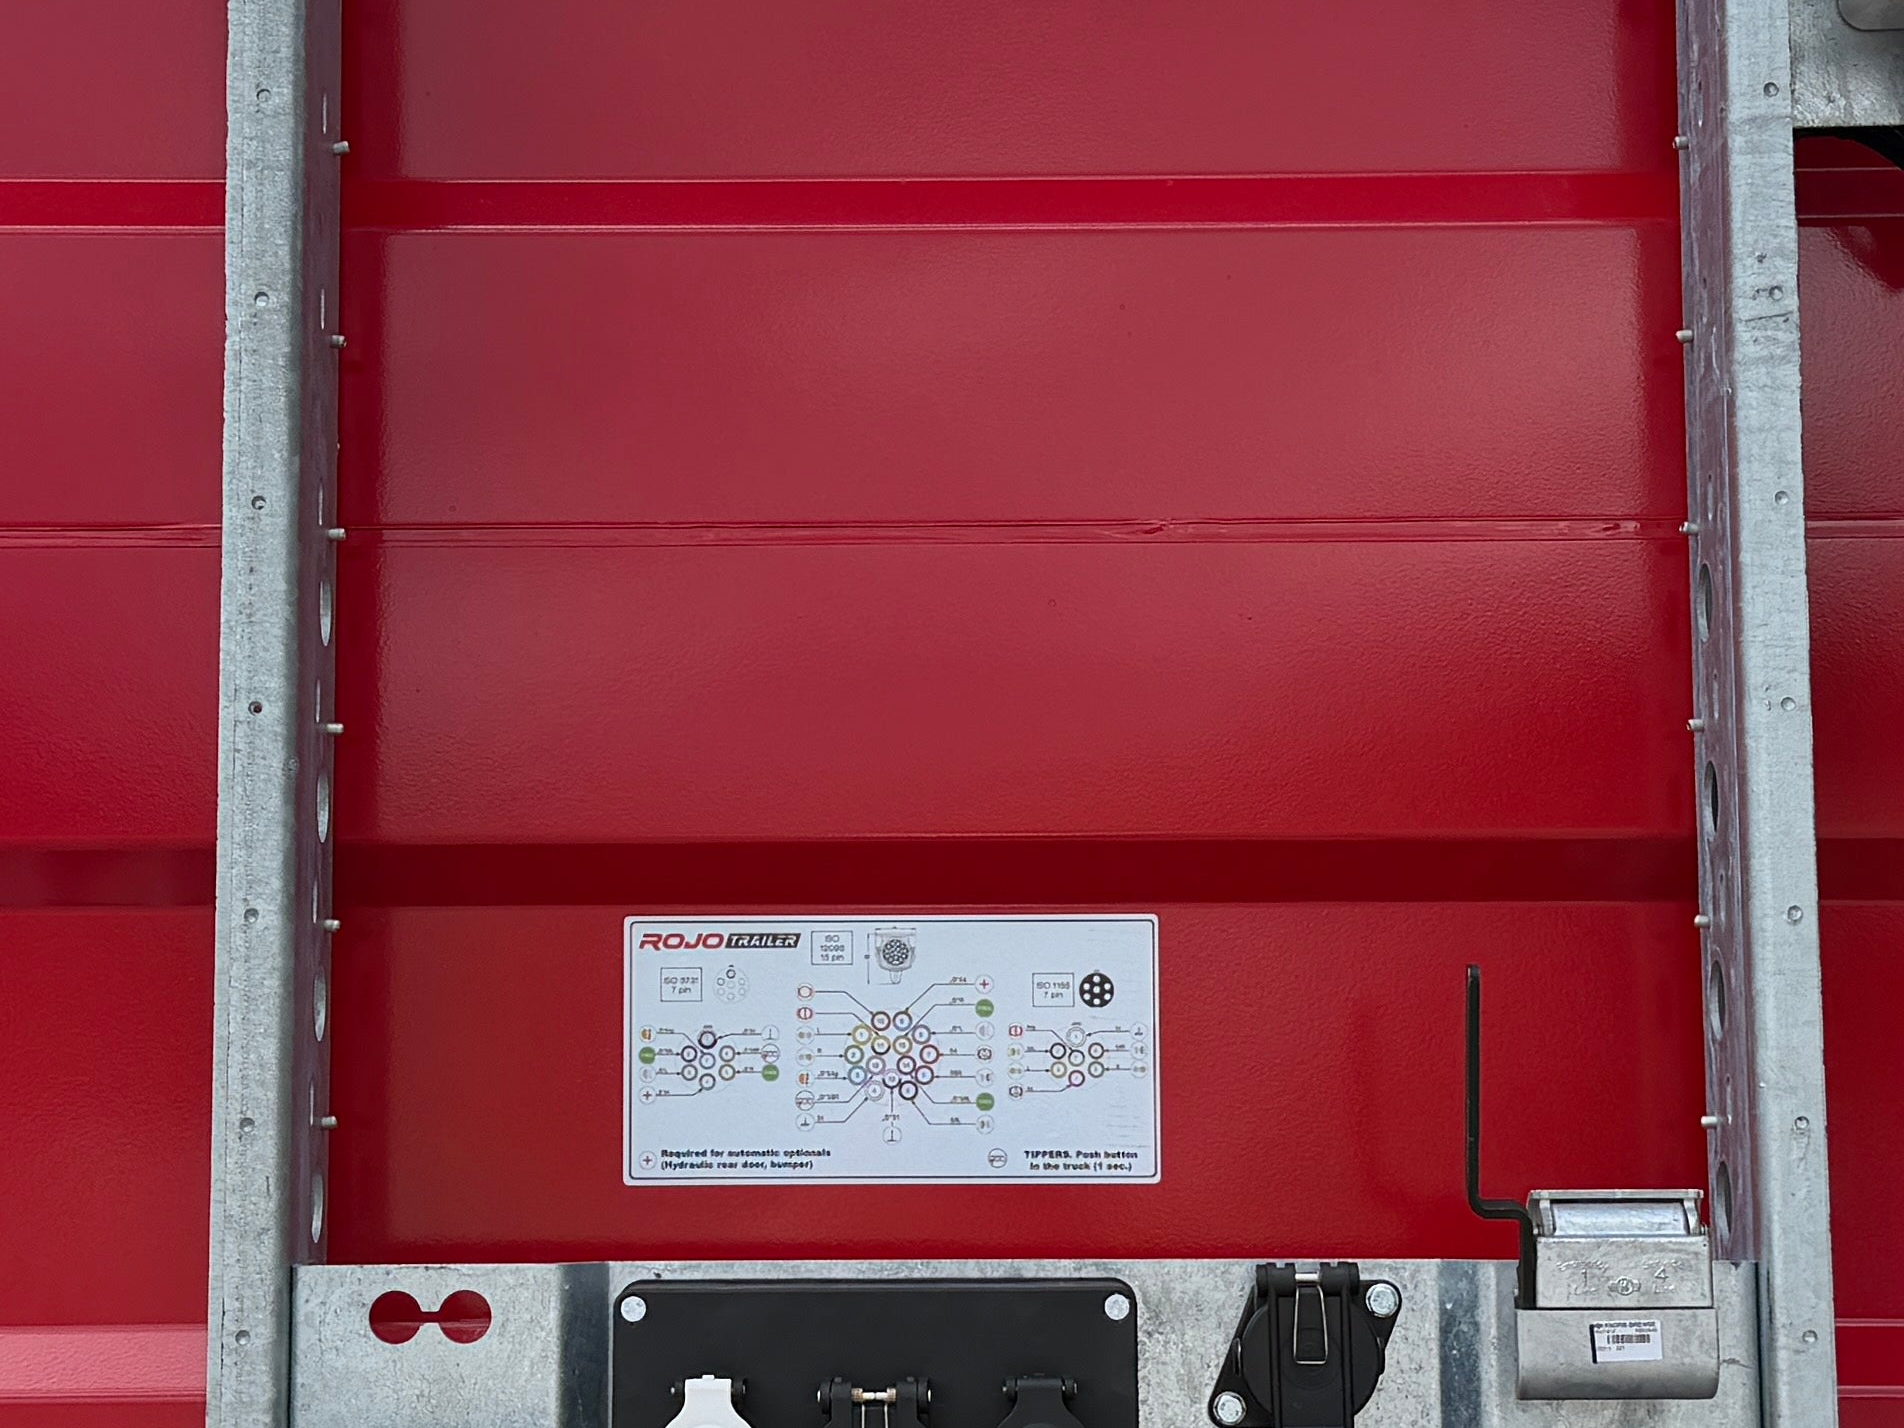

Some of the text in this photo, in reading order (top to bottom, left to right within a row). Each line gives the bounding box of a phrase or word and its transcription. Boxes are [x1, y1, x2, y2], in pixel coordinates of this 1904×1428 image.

[638, 933, 797, 951] ROJO TRAILER
[661, 1149, 831, 1159] Required for automatic optionals
[1024, 1151, 1138, 1159] TIPPERS. Push button
[661, 1160, 714, 1171] (Hydraulic
[741, 1160, 768, 1170] door,
[770, 1160, 814, 1170] bumper)
[1043, 1162, 1061, 1170] the
[1063, 1162, 1091, 1170] truck
[1106, 1162, 1133, 1172] sec.)
